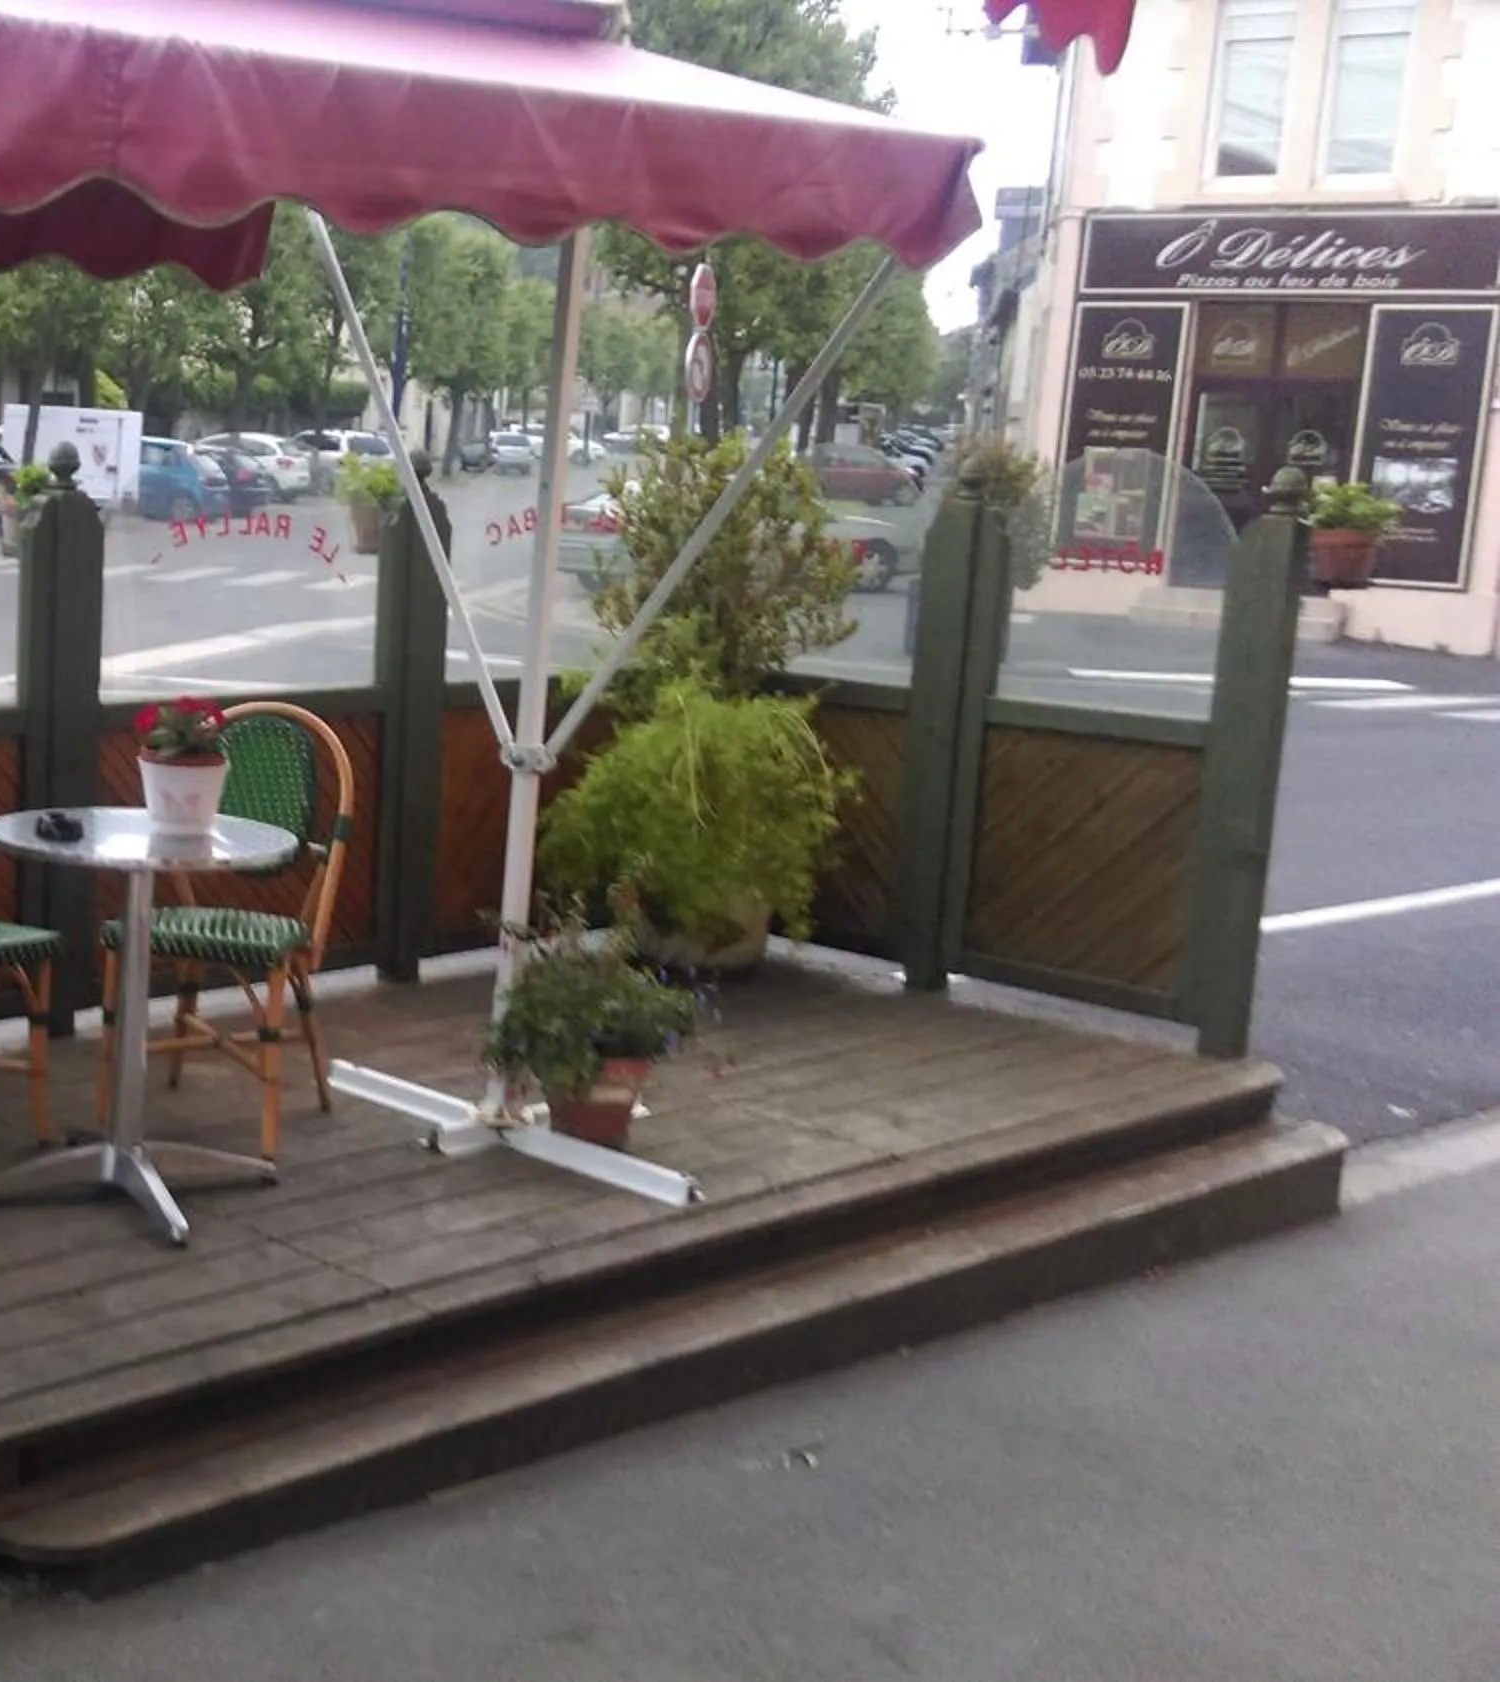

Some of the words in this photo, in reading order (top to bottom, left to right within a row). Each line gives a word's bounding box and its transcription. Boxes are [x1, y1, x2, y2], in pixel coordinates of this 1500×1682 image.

[1210, 228, 1427, 270] Délices
[1175, 272, 1238, 288] Pizzas
[1243, 276, 1270, 288] au
[1279, 272, 1313, 288] feu
[1318, 273, 1348, 288] de
[1353, 272, 1400, 288] bois
